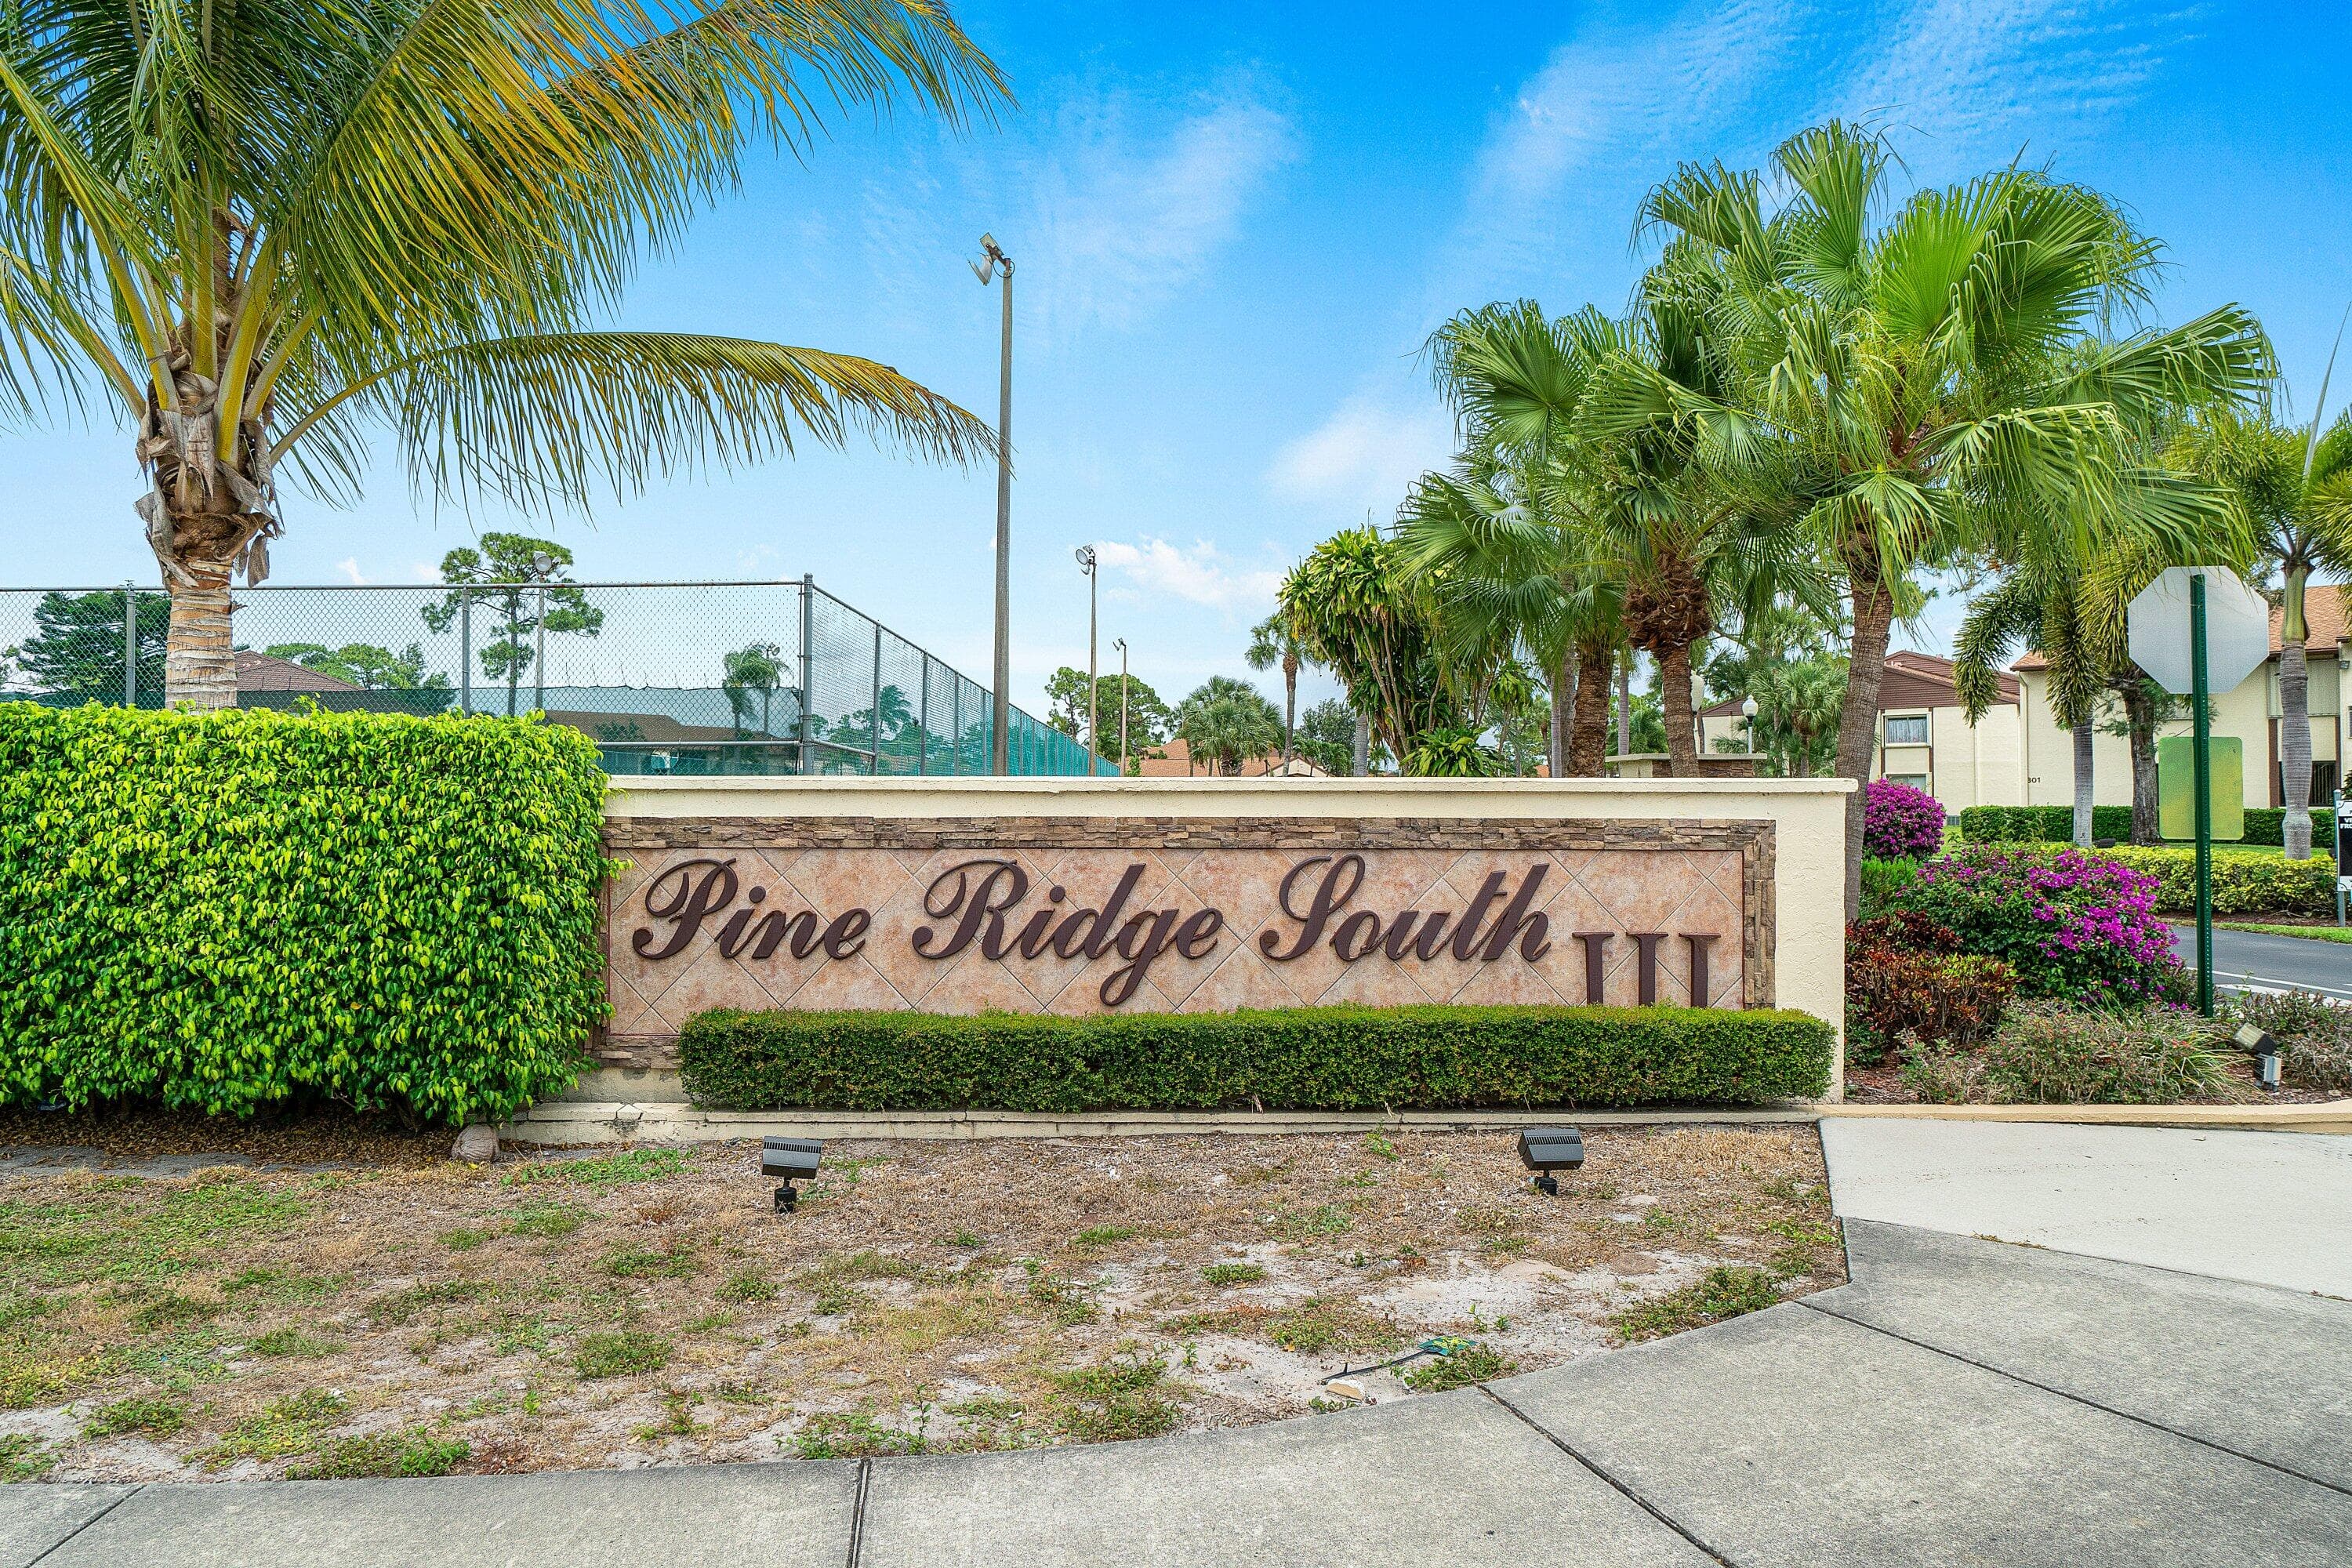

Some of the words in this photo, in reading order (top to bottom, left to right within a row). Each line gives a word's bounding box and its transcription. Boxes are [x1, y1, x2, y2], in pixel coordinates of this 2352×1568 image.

[632, 857, 872, 961] Pine
[911, 858, 1225, 1007] Ridge
[1260, 853, 1551, 962] South
[1572, 931, 1722, 1008] III
